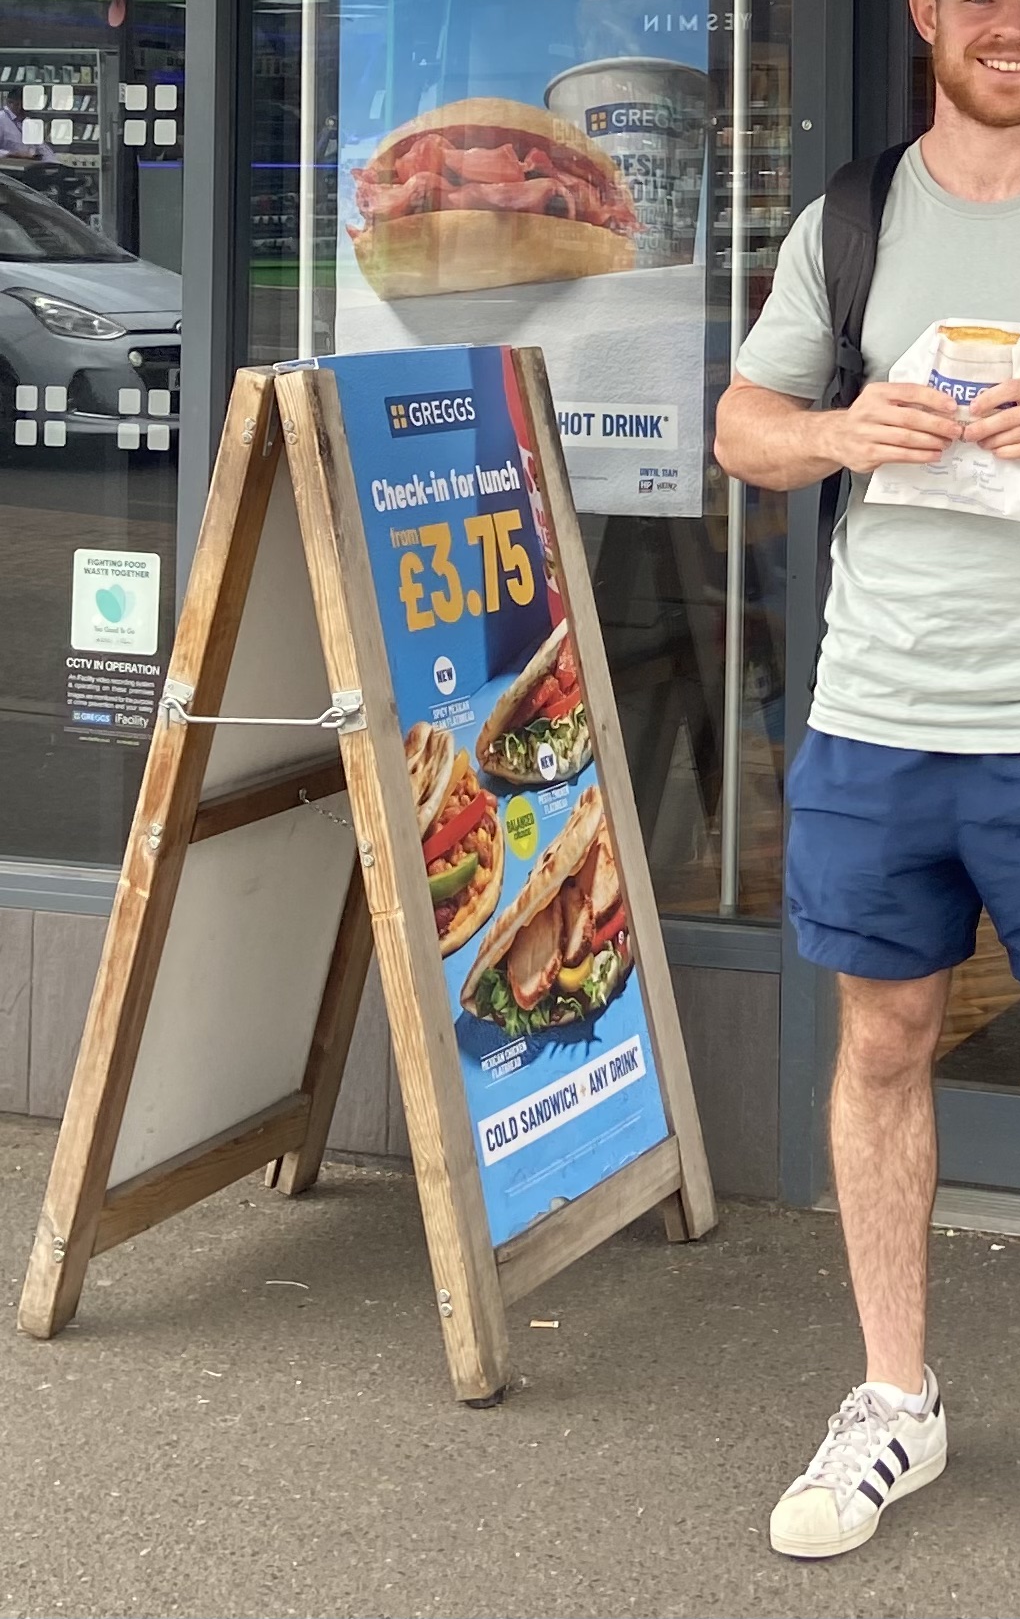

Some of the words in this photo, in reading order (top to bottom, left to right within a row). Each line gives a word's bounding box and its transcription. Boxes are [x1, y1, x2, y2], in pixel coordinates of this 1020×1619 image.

[408, 396, 476, 427] GREGGS
[558, 412, 595, 436] HOT
[371, 469, 450, 513] Check-in
[450, 467, 476, 499] for
[475, 460, 520, 495] lunch
[390, 526, 420, 549] from
[83, 567, 109, 576] WASTE
[111, 568, 150, 579] TOGETHER
[87, 558, 122, 568] FIGHTING
[124, 560, 147, 569] FOOD
[399, 509, 535, 632] £3.75
[66, 657, 93, 670] CCTV
[93, 660, 104, 670] IN
[105, 661, 161, 676] OPERATION
[436, 667, 453, 683] NEW
[540, 753, 554, 770] NEW
[486, 1116, 519, 1153] COLD
[520, 1082, 580, 1134] SANDWICH
[589, 1067, 610, 1095] ANY
